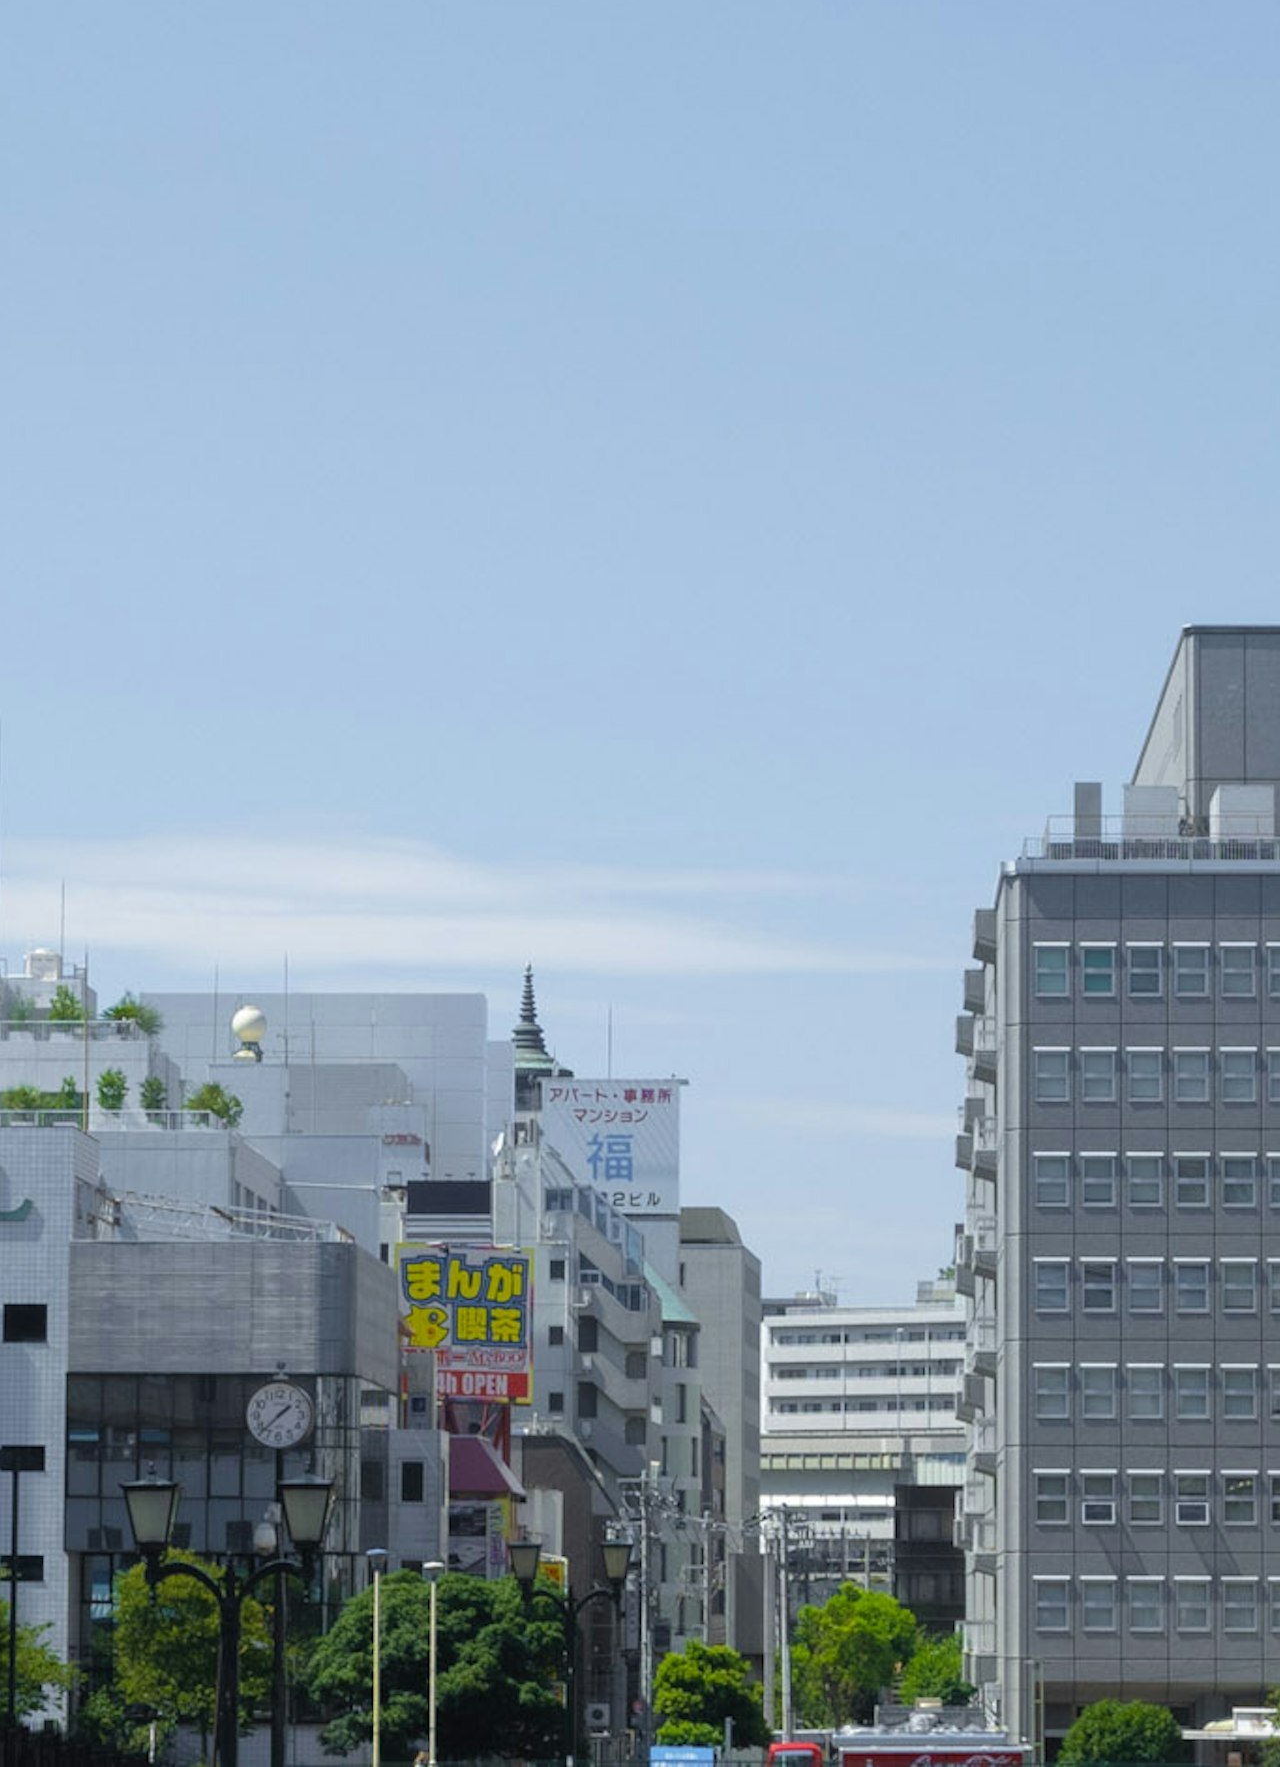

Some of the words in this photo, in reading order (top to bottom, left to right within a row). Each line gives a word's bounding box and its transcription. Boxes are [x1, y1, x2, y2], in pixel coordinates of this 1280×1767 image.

[548, 1087, 673, 1104] アパート・事務所
[573, 1107, 649, 1123] マンション
[585, 1133, 634, 1182] 福
[406, 1259, 523, 1303] まんが
[457, 1307, 521, 1342] 喫茶
[462, 1373, 508, 1396] OPEN
